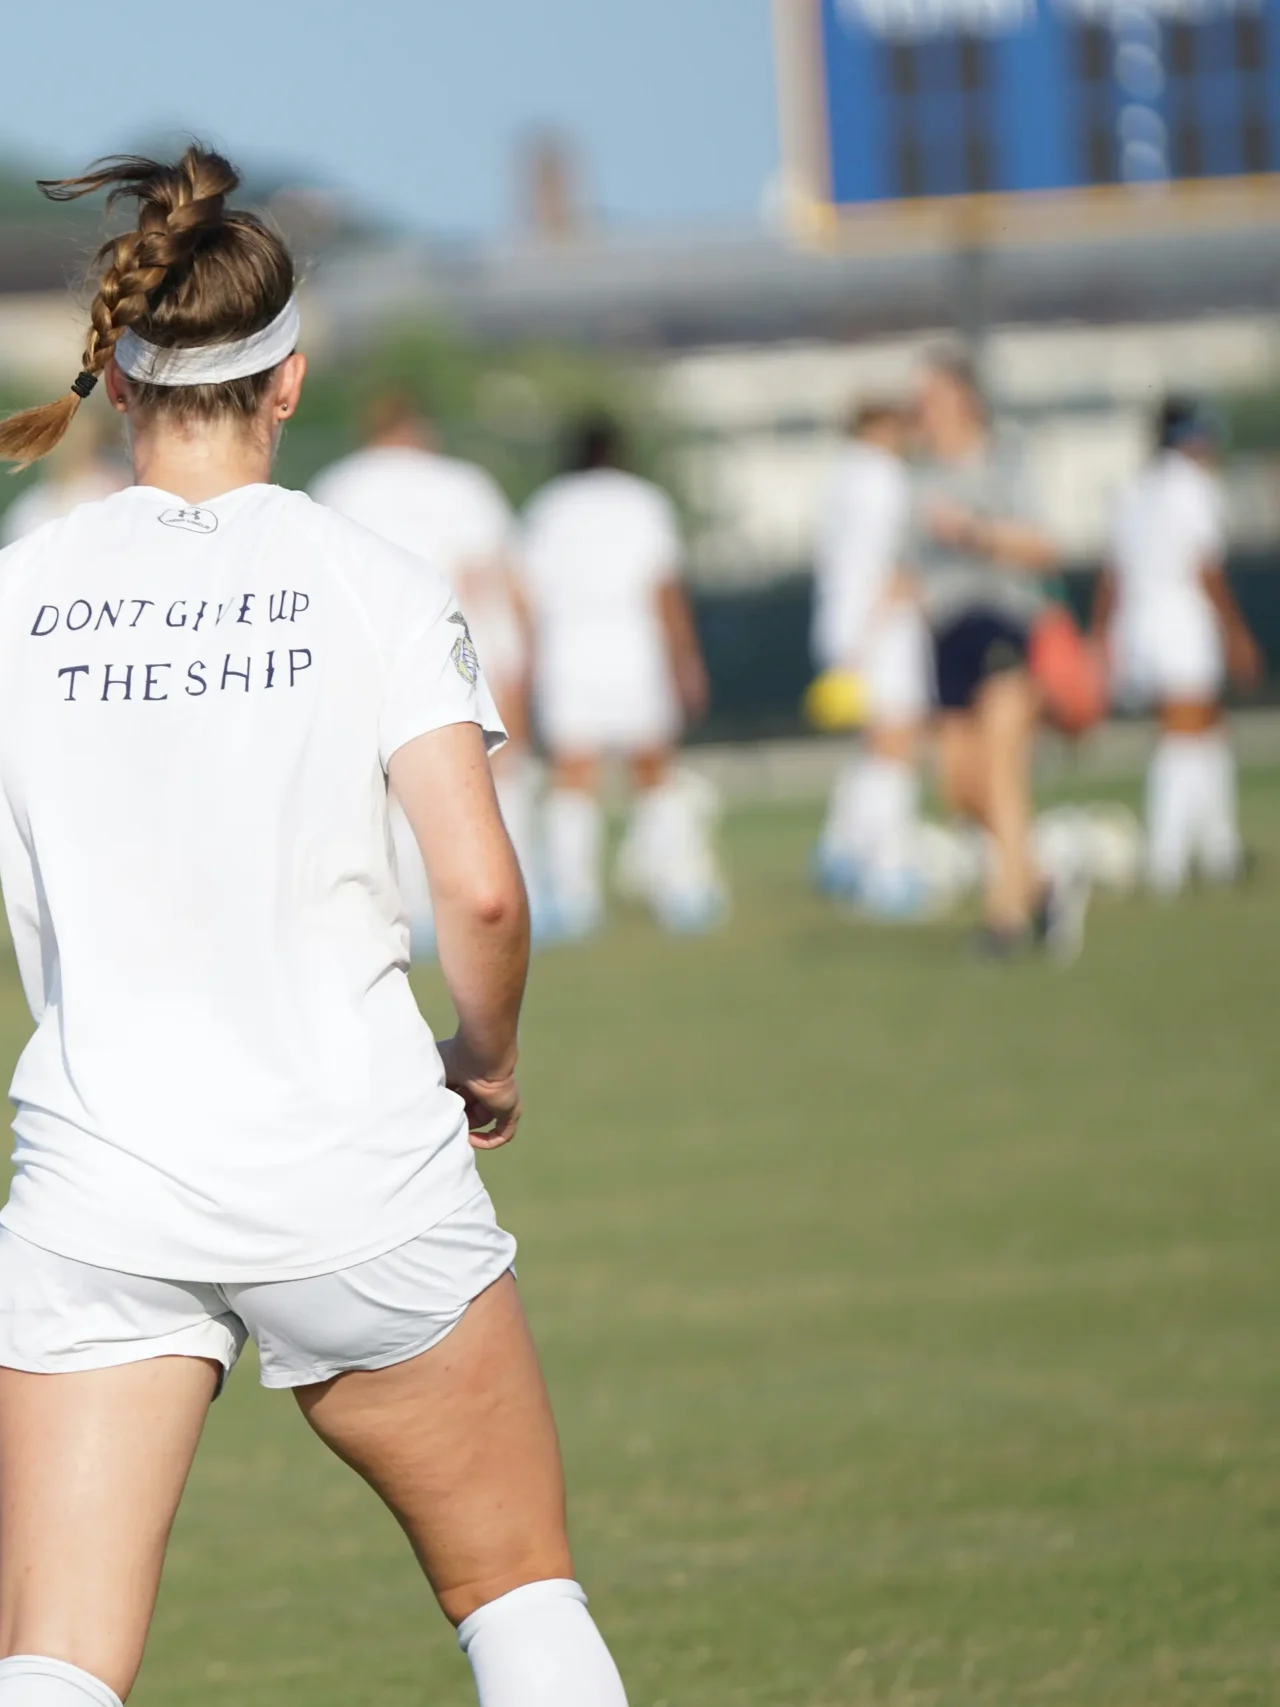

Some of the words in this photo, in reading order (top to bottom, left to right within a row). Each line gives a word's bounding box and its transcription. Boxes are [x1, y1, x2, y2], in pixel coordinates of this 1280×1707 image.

[30, 598, 155, 637] DONT
[166, 593, 256, 632] GIVE
[269, 589, 310, 623] UP
[58, 662, 172, 701] THE
[185, 648, 312, 697] SHIP
